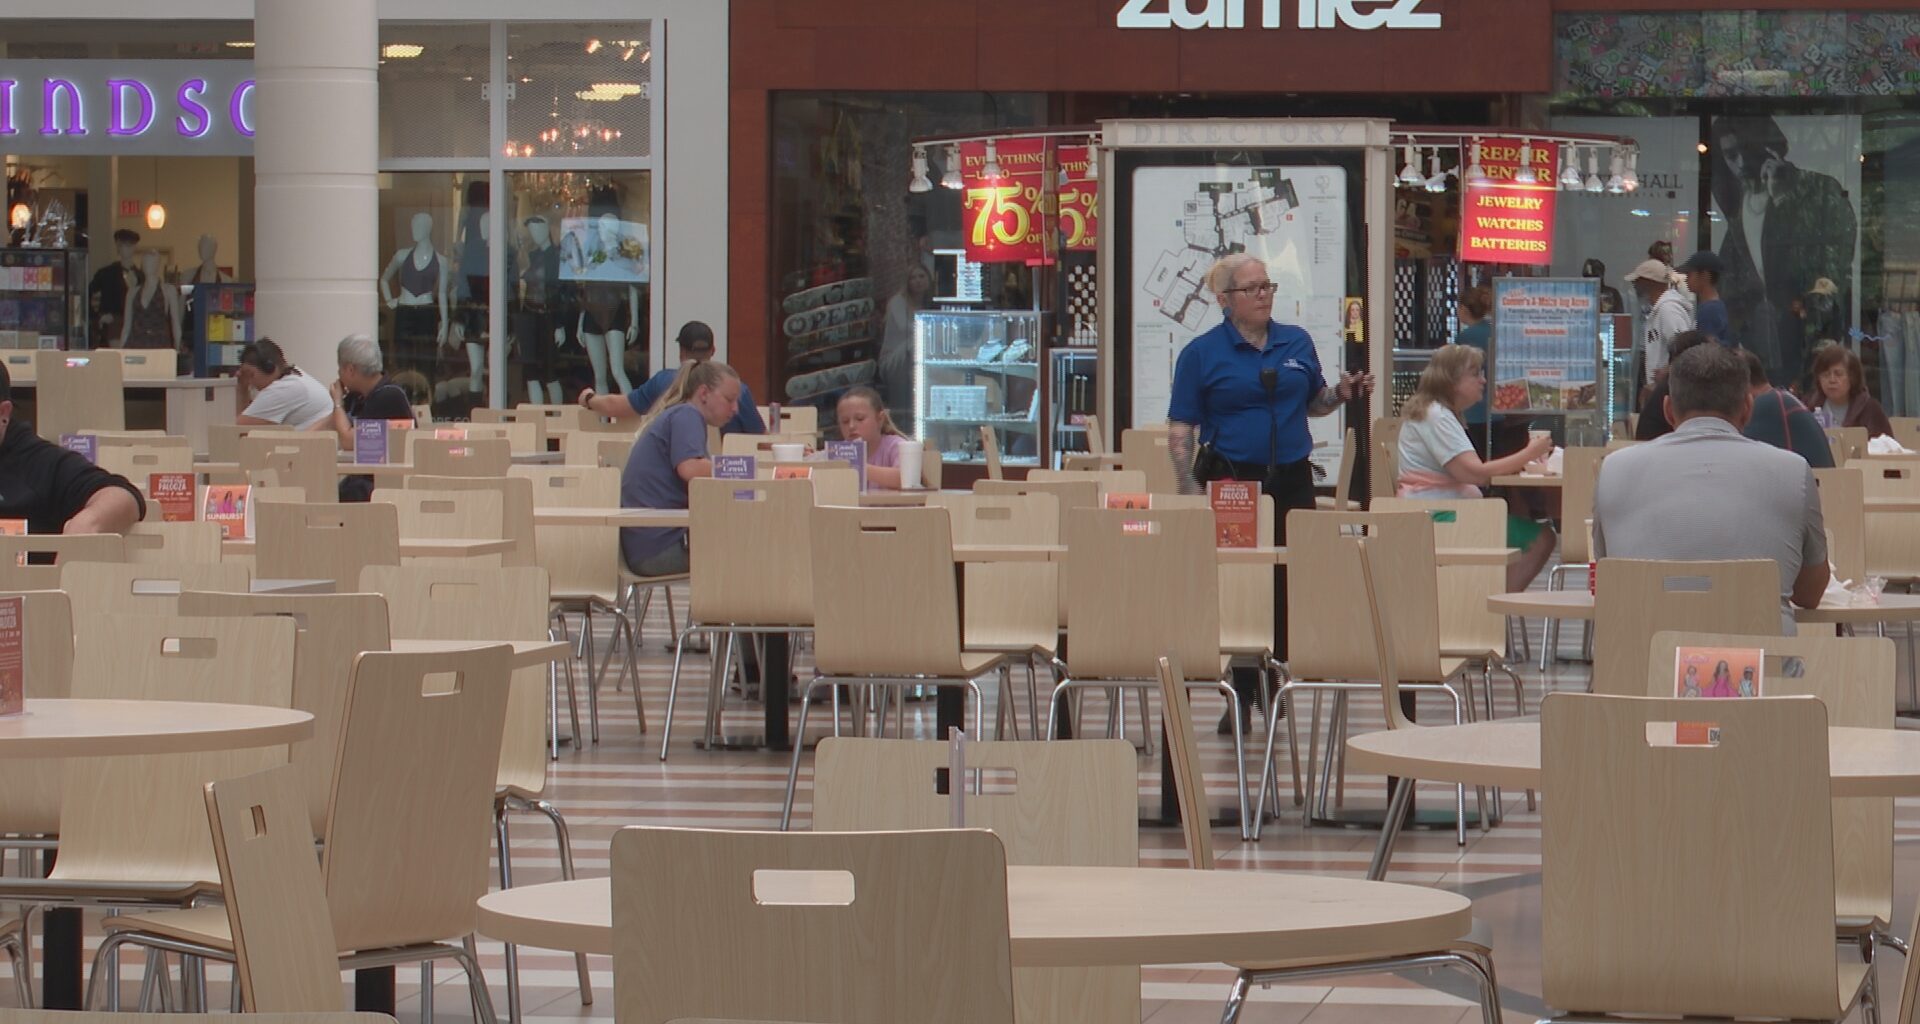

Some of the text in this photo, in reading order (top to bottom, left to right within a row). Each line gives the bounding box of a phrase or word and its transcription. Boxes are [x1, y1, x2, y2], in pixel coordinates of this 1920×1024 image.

[1133, 123, 1349, 144] DIRECTORY
[965, 152, 1044, 167] EVYTHING
[1481, 165, 1552, 182] ENR
[1477, 195, 1543, 210] JEWELRY
[1477, 217, 1544, 232] WATCHES
[1026, 233, 1043, 244] OF
[1470, 236, 1547, 252] BATTERIES
[207, 512, 244, 520] SUNBURST
